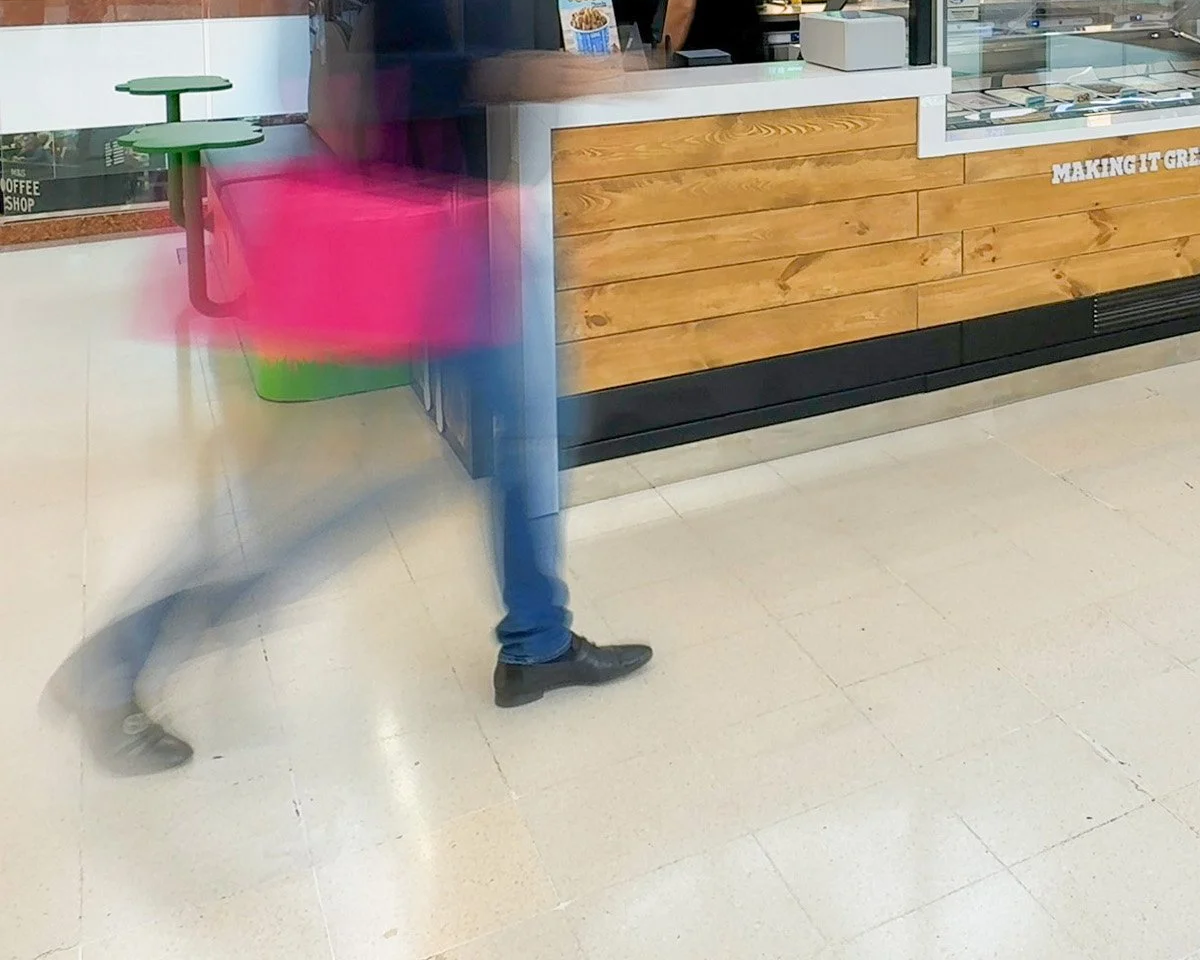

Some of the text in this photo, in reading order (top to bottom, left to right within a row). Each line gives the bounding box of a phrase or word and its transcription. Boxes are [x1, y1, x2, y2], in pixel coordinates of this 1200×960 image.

[1052, 154, 1137, 184] MAKING
[1138, 151, 1162, 173] IT
[1, 178, 40, 196] OFFEE
[5, 195, 35, 212] SHOP
